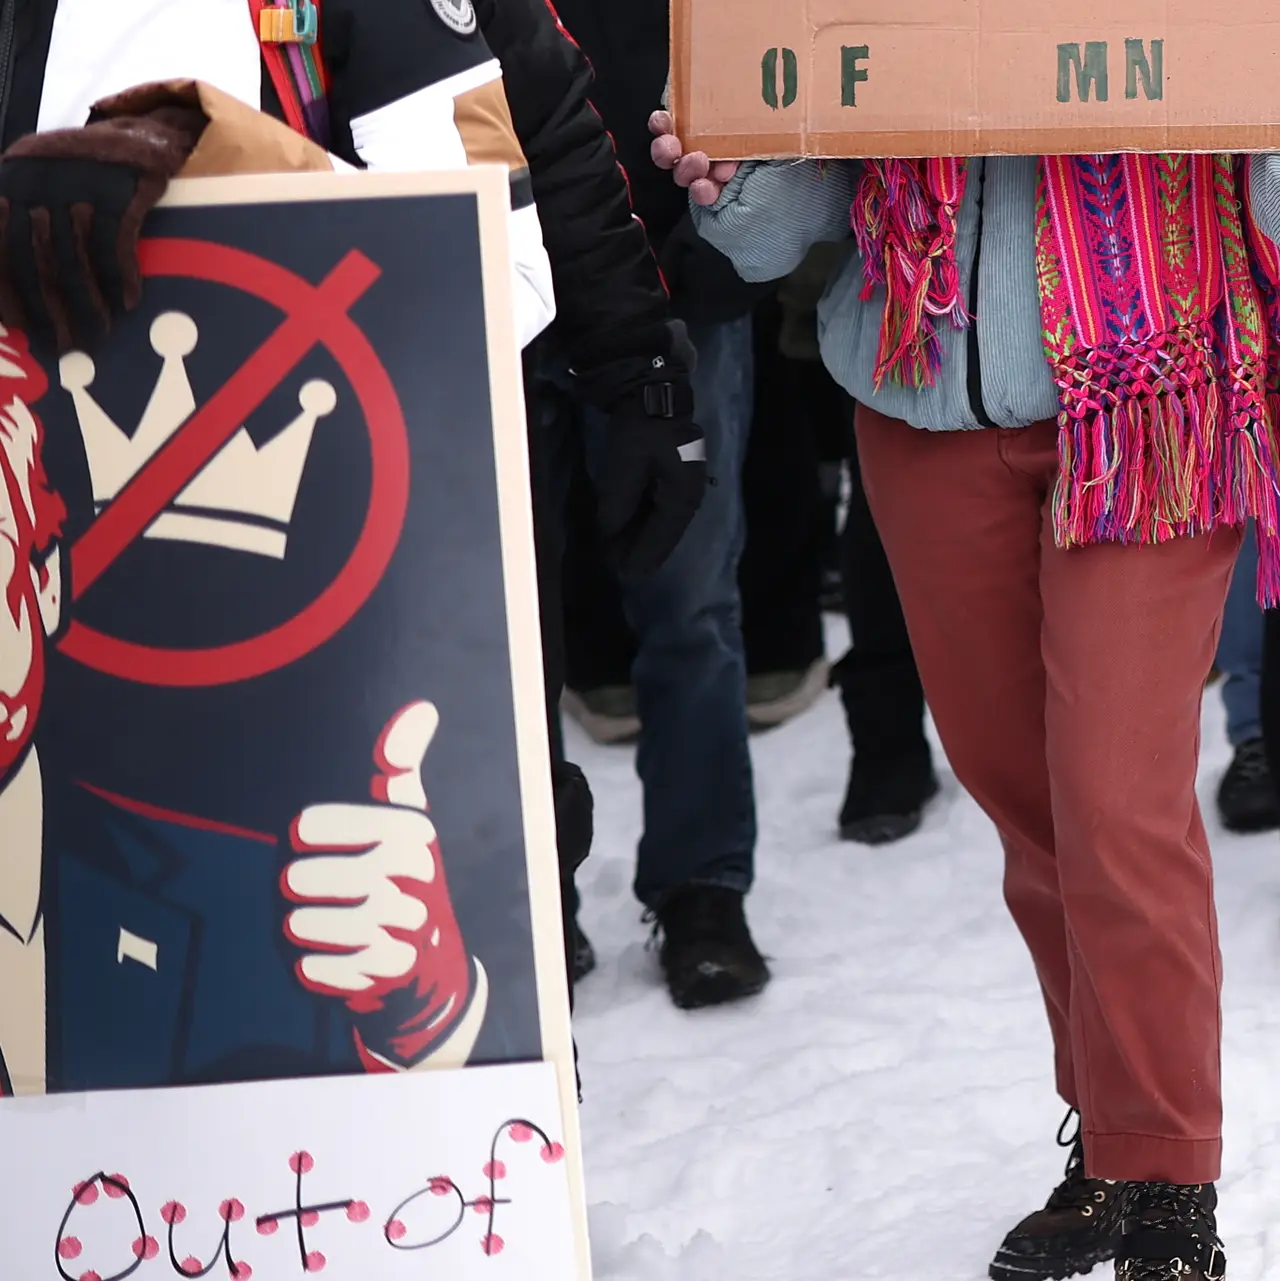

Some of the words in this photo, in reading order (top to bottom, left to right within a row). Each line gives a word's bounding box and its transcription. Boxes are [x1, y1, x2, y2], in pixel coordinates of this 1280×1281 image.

[760, 43, 871, 111] OF
[1056, 37, 1165, 104] MN
[383, 1118, 565, 1257] of
